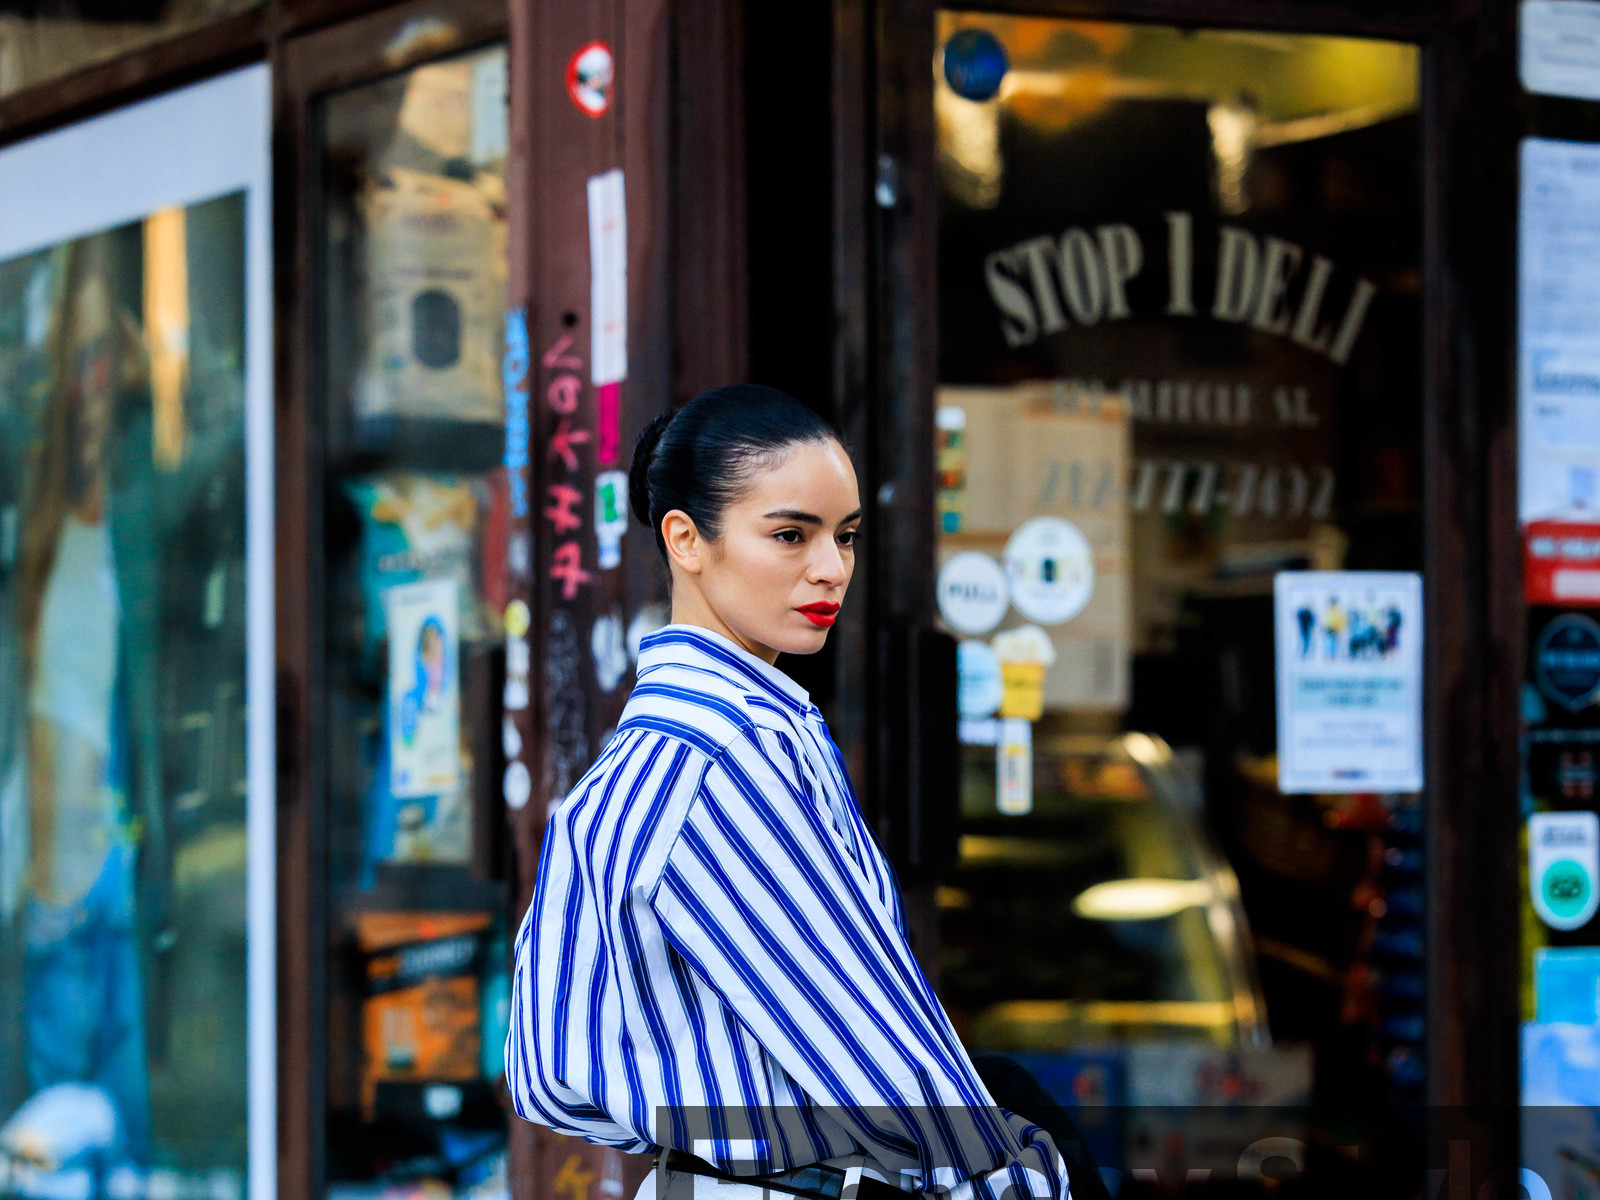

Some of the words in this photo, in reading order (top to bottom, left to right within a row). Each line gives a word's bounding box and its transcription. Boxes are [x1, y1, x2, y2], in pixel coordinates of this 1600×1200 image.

[984, 223, 1144, 348] STOP
[1163, 210, 1197, 317] 1
[1211, 225, 1378, 366] DELI
